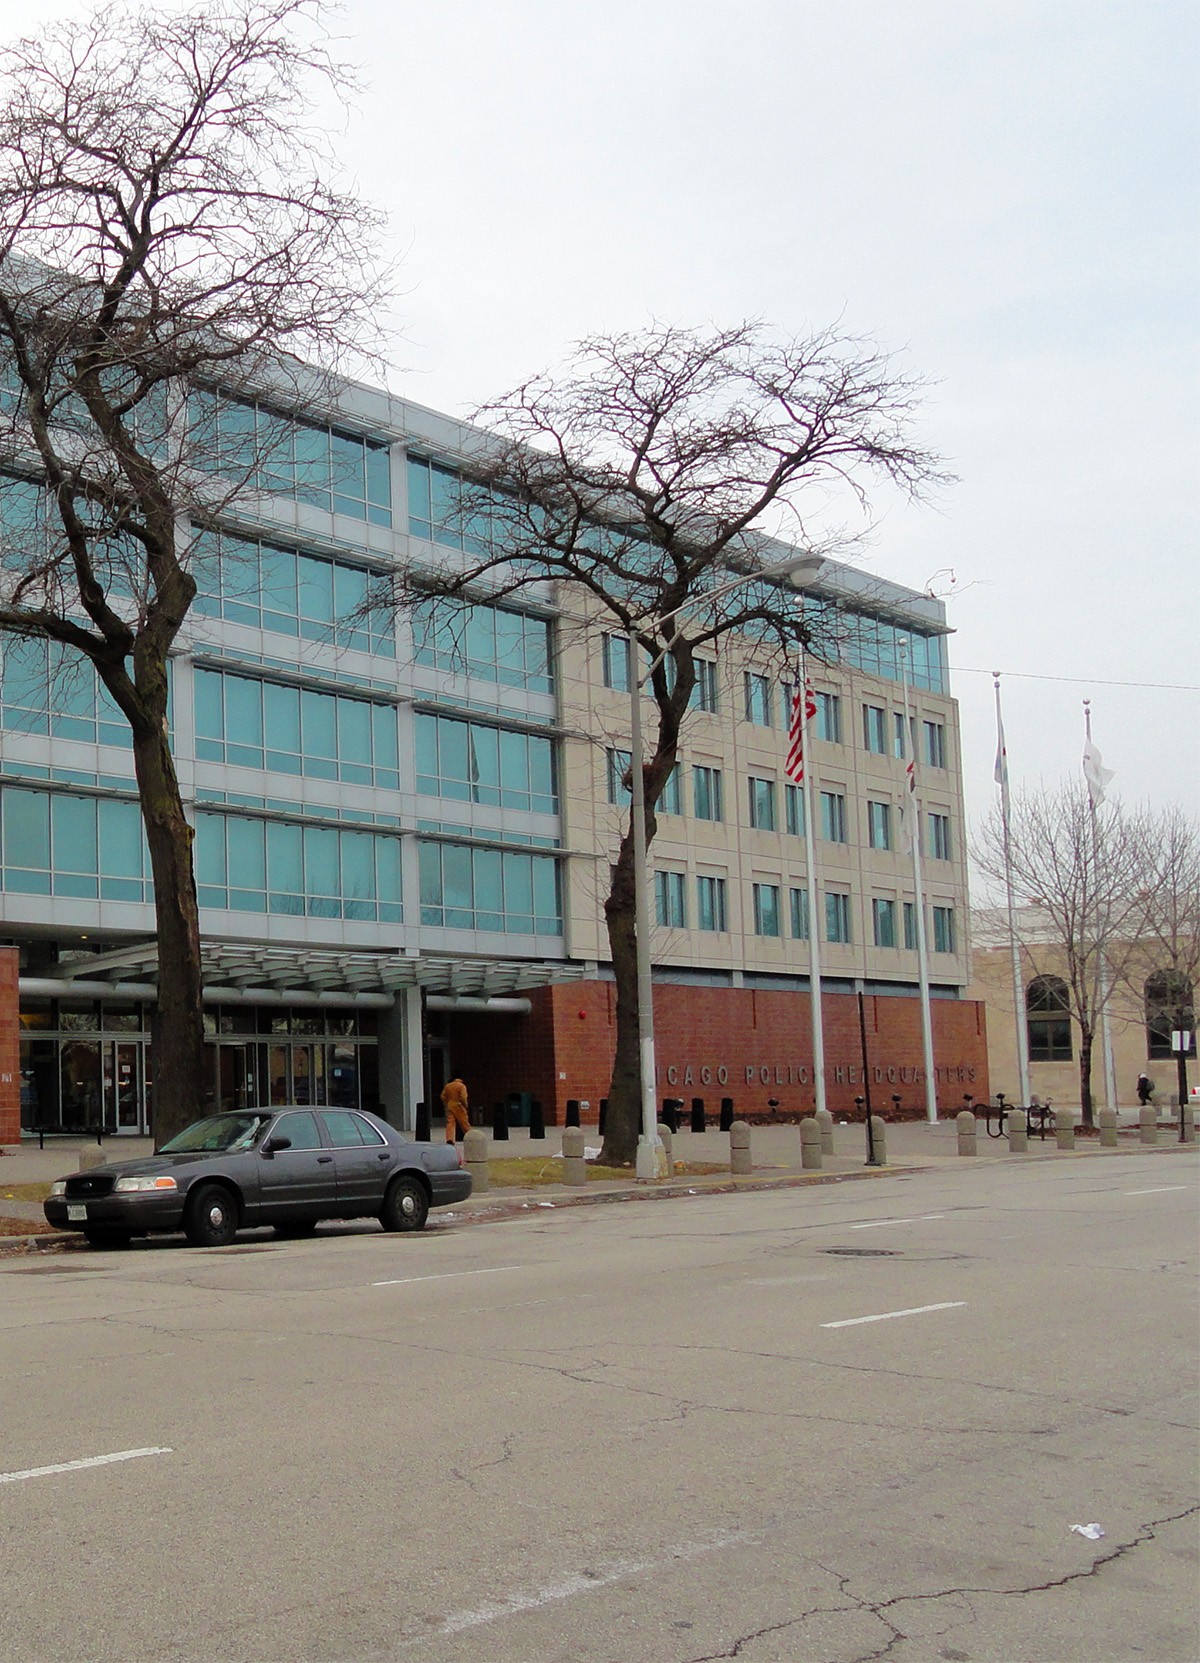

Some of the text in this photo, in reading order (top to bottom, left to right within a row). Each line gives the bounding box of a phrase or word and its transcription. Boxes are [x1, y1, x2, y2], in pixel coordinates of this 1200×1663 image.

[654, 1065, 977, 1086] ICAGO POLIC HEDQUATERS
